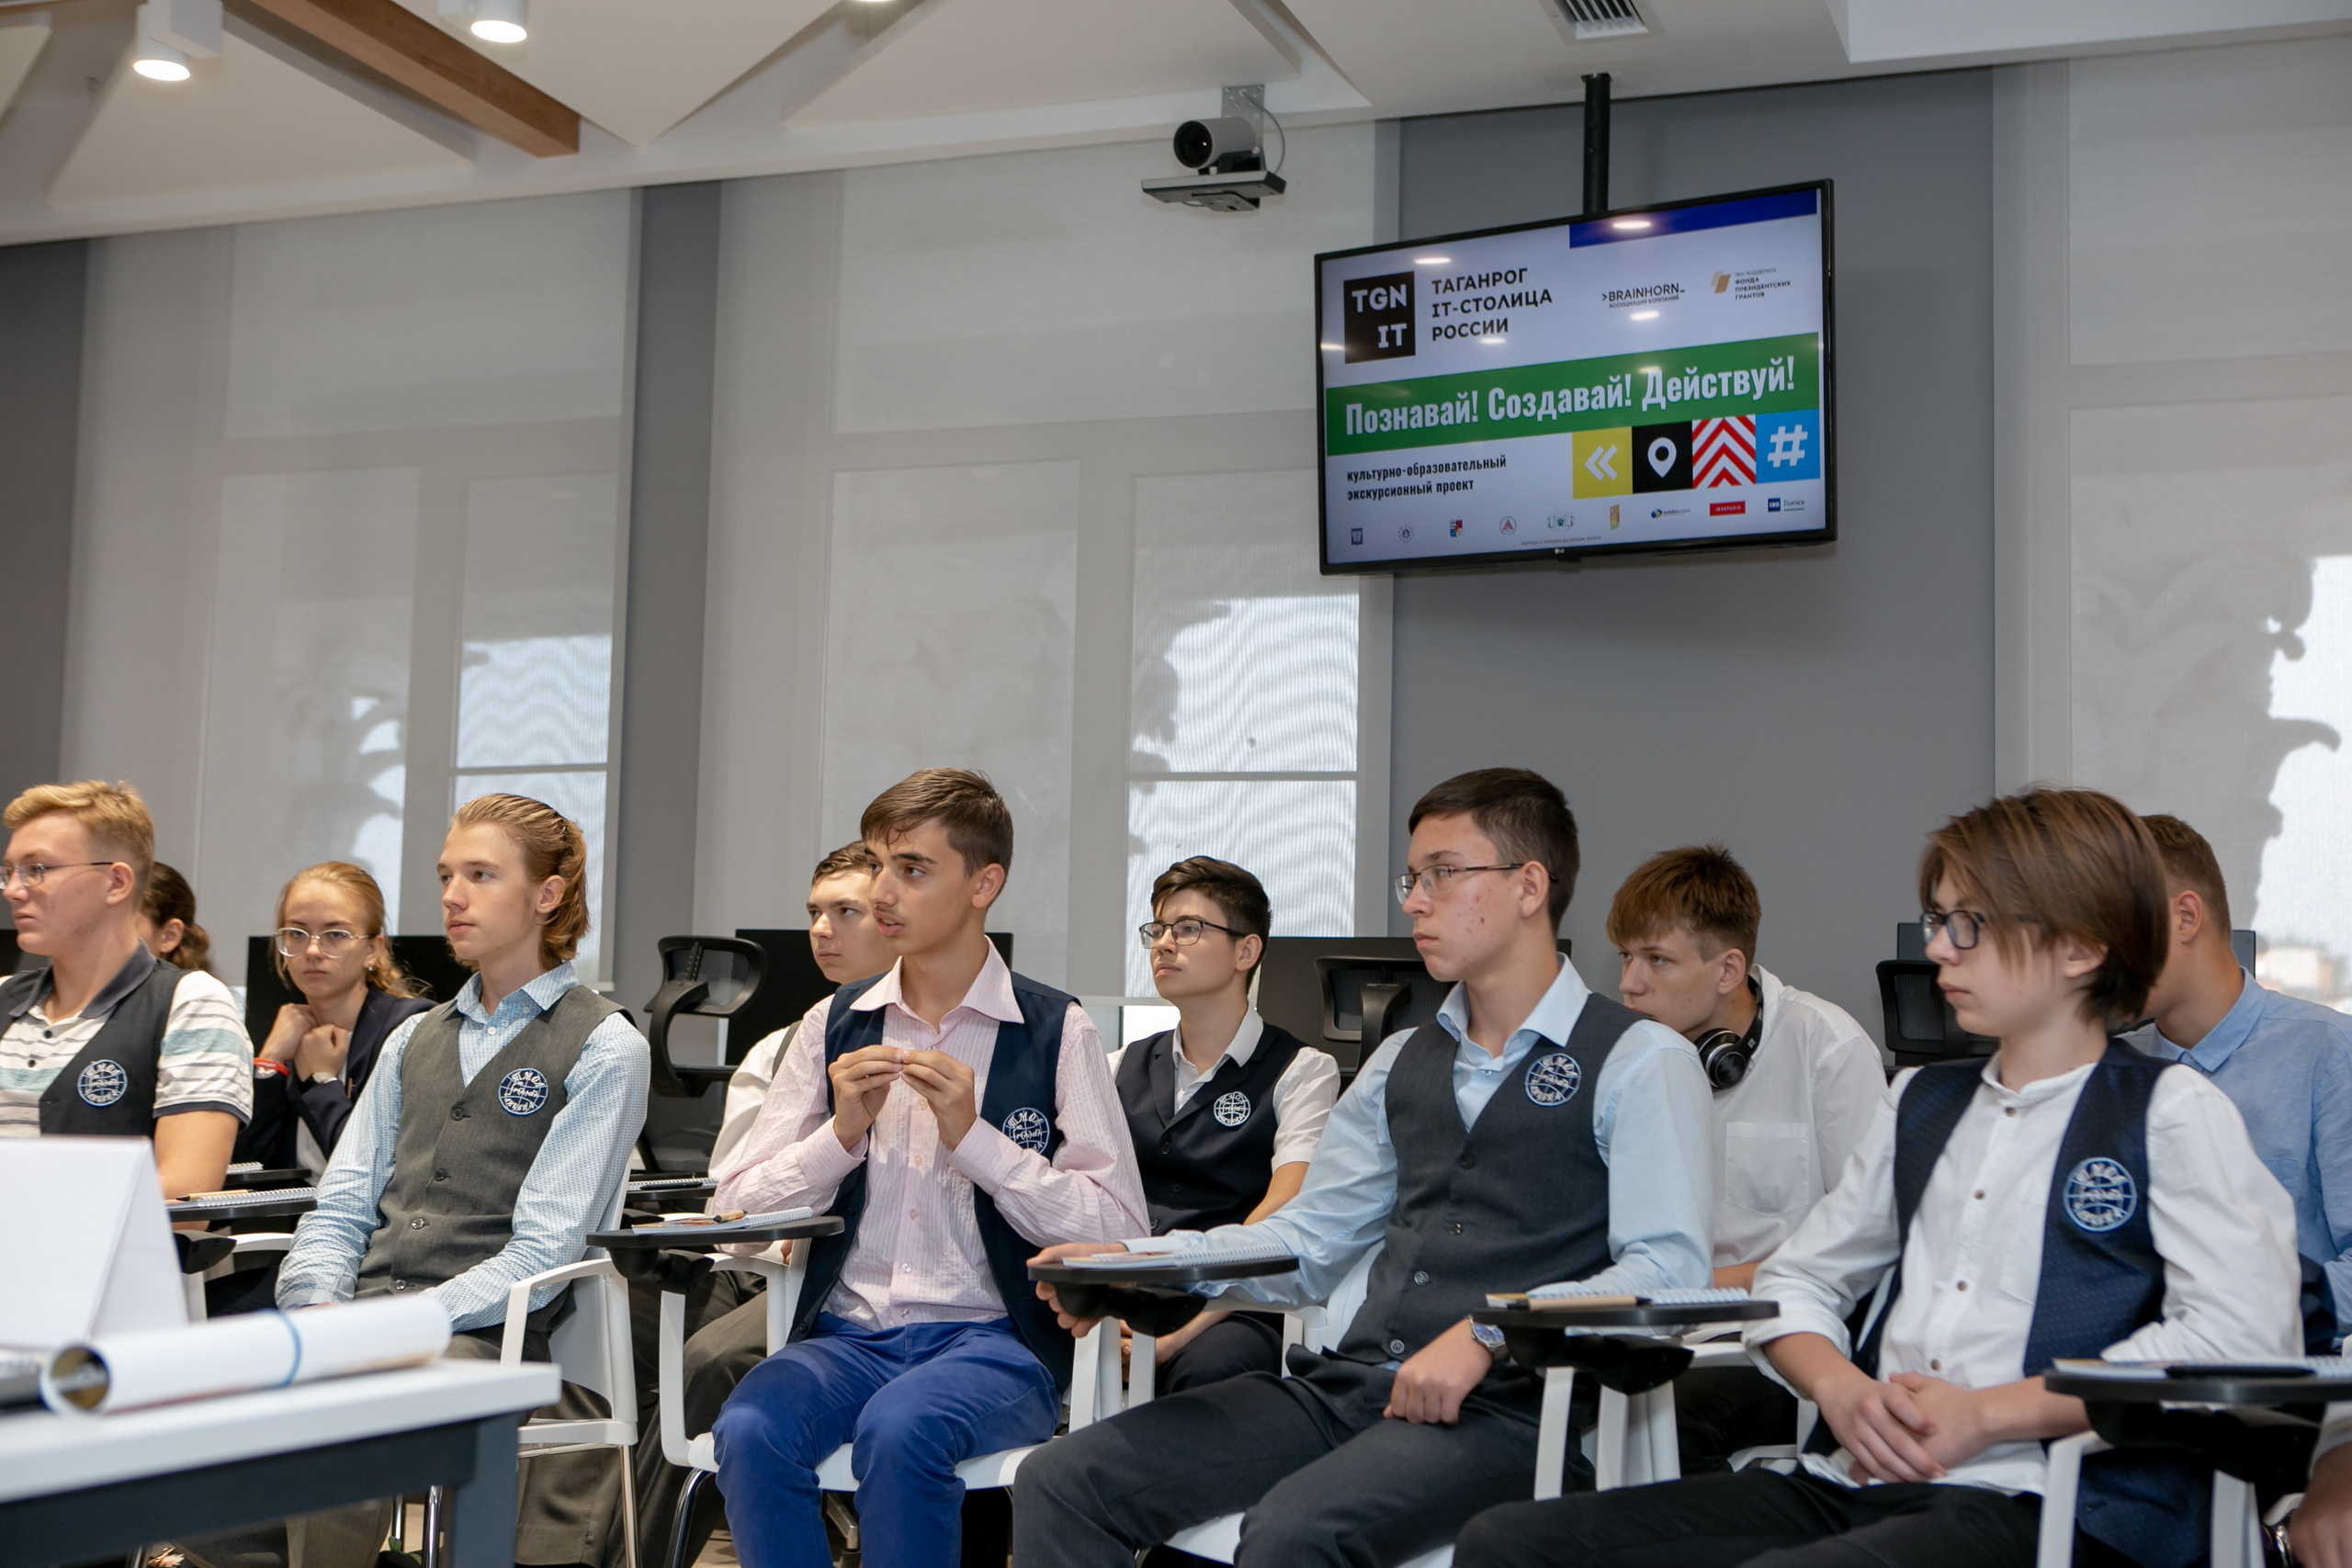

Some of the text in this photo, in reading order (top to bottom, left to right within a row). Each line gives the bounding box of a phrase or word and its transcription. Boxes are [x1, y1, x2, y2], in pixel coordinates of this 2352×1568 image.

[1431, 267, 1528, 294] ТАГАНРОГ
[1735, 280, 1791, 293] ПРЕЗИДЕНТСКИХ
[1351, 284, 1408, 313] TGN
[1431, 288, 1553, 318] IT-СТОЛИЦА
[1735, 291, 1765, 300] ГРАНТОВ
[1378, 322, 1408, 348] IT
[1431, 318, 1509, 341] РОССИИ
[1345, 355, 1795, 435] Познавай! Создавай! Действуй!
[1347, 454, 1507, 483] культурно-образовательный
[1347, 479, 1475, 502] экскурсионный проект
